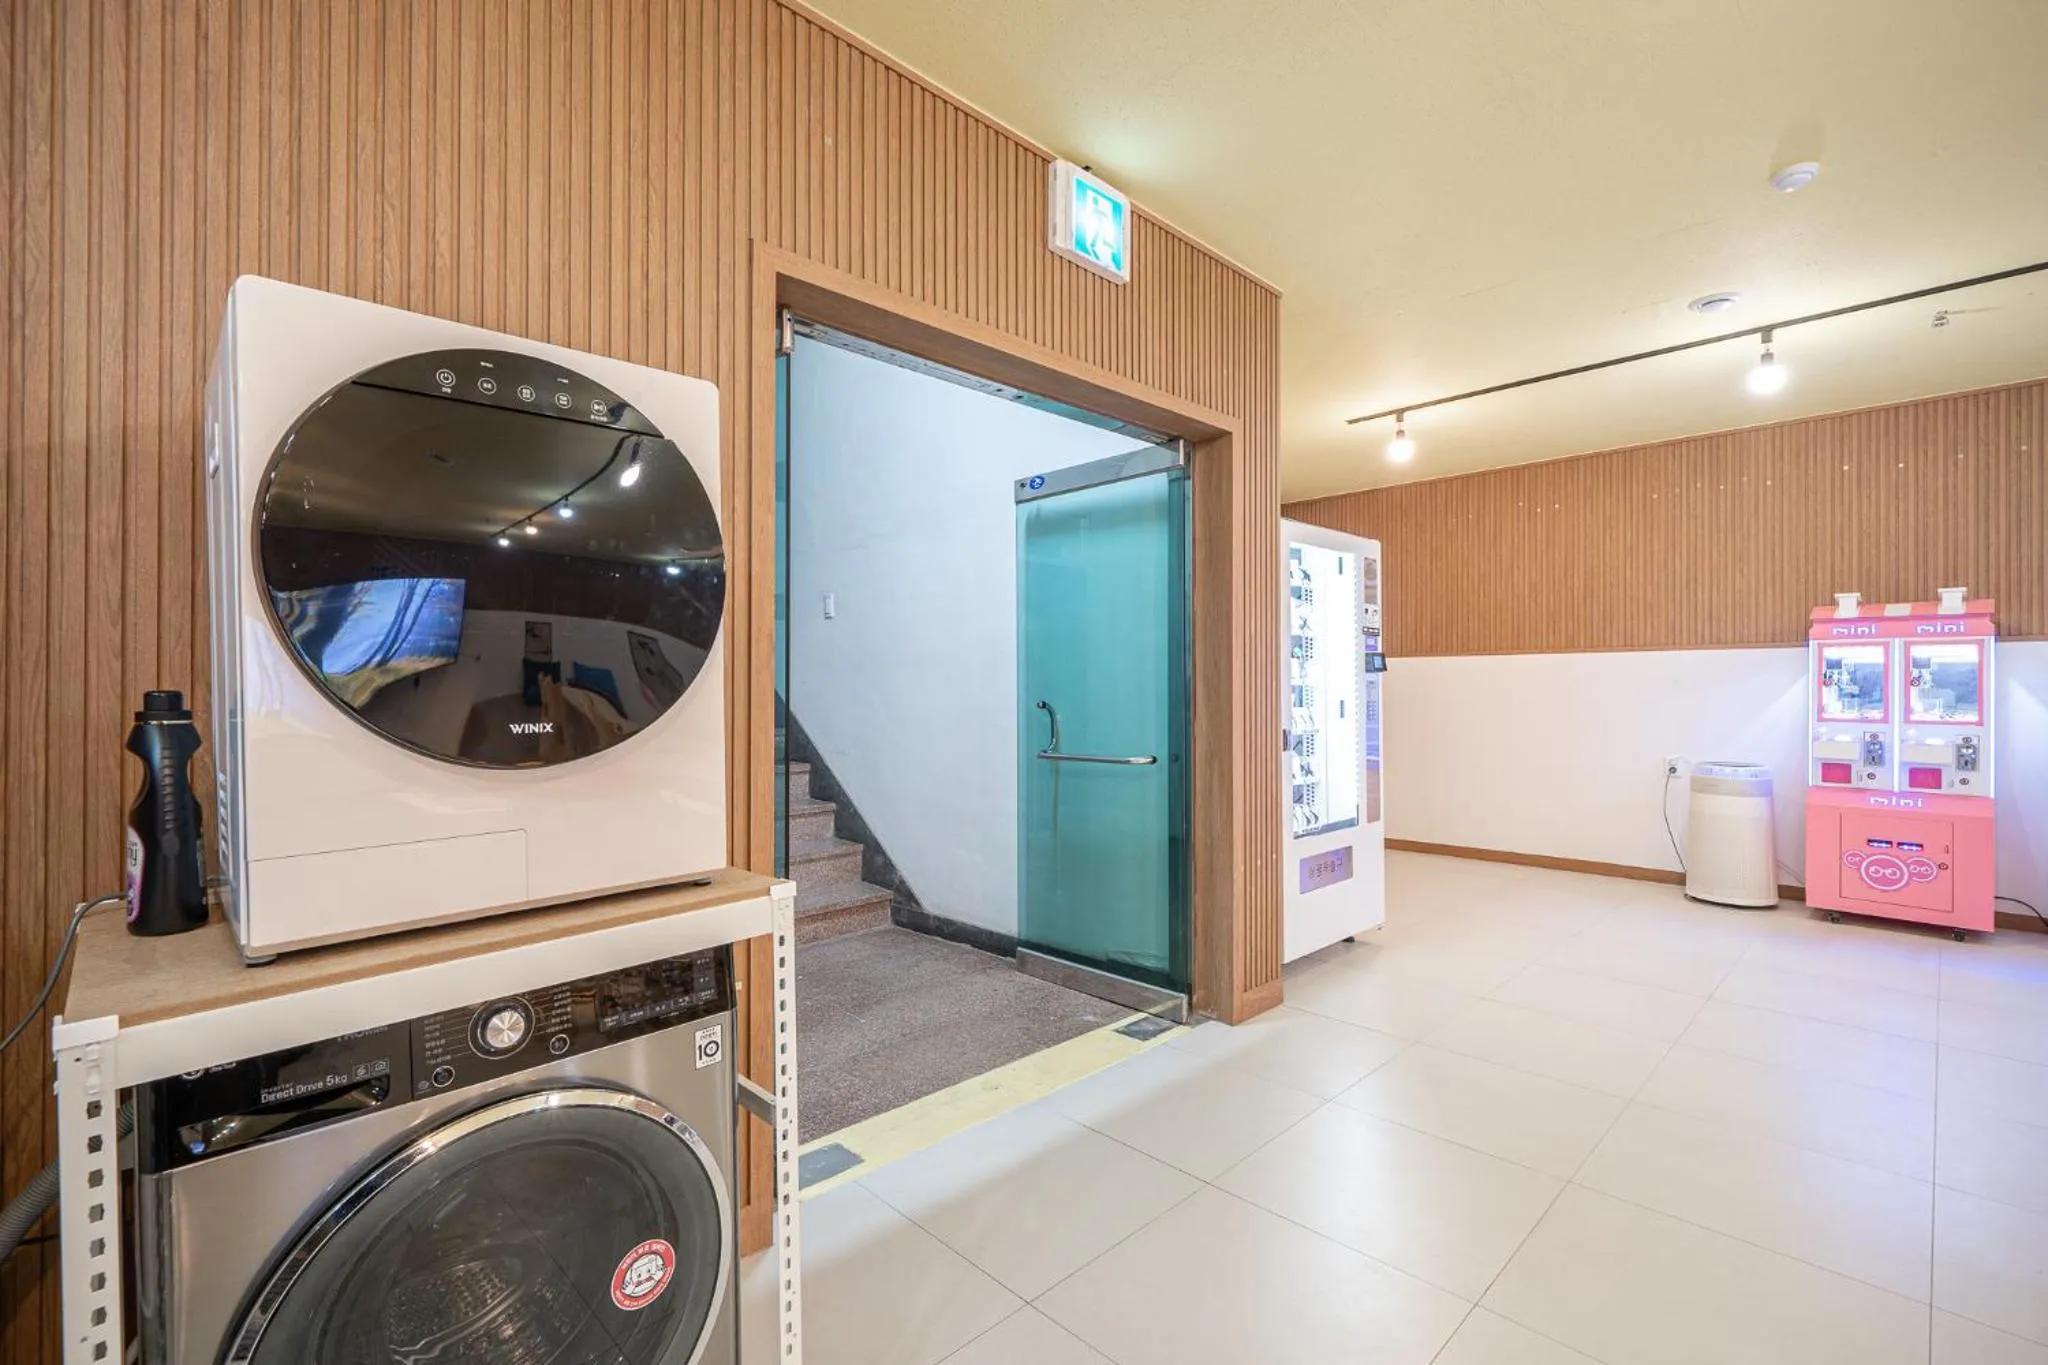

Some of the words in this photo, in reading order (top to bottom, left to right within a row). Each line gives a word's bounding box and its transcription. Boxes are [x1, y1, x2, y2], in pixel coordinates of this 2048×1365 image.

[1832, 624, 1876, 636] mini
[1916, 622, 1965, 634] mini
[508, 722, 554, 734] WINIX
[1870, 796, 1922, 808] mini
[261, 1087, 295, 1104] Direct
[296, 1080, 323, 1096] Drive
